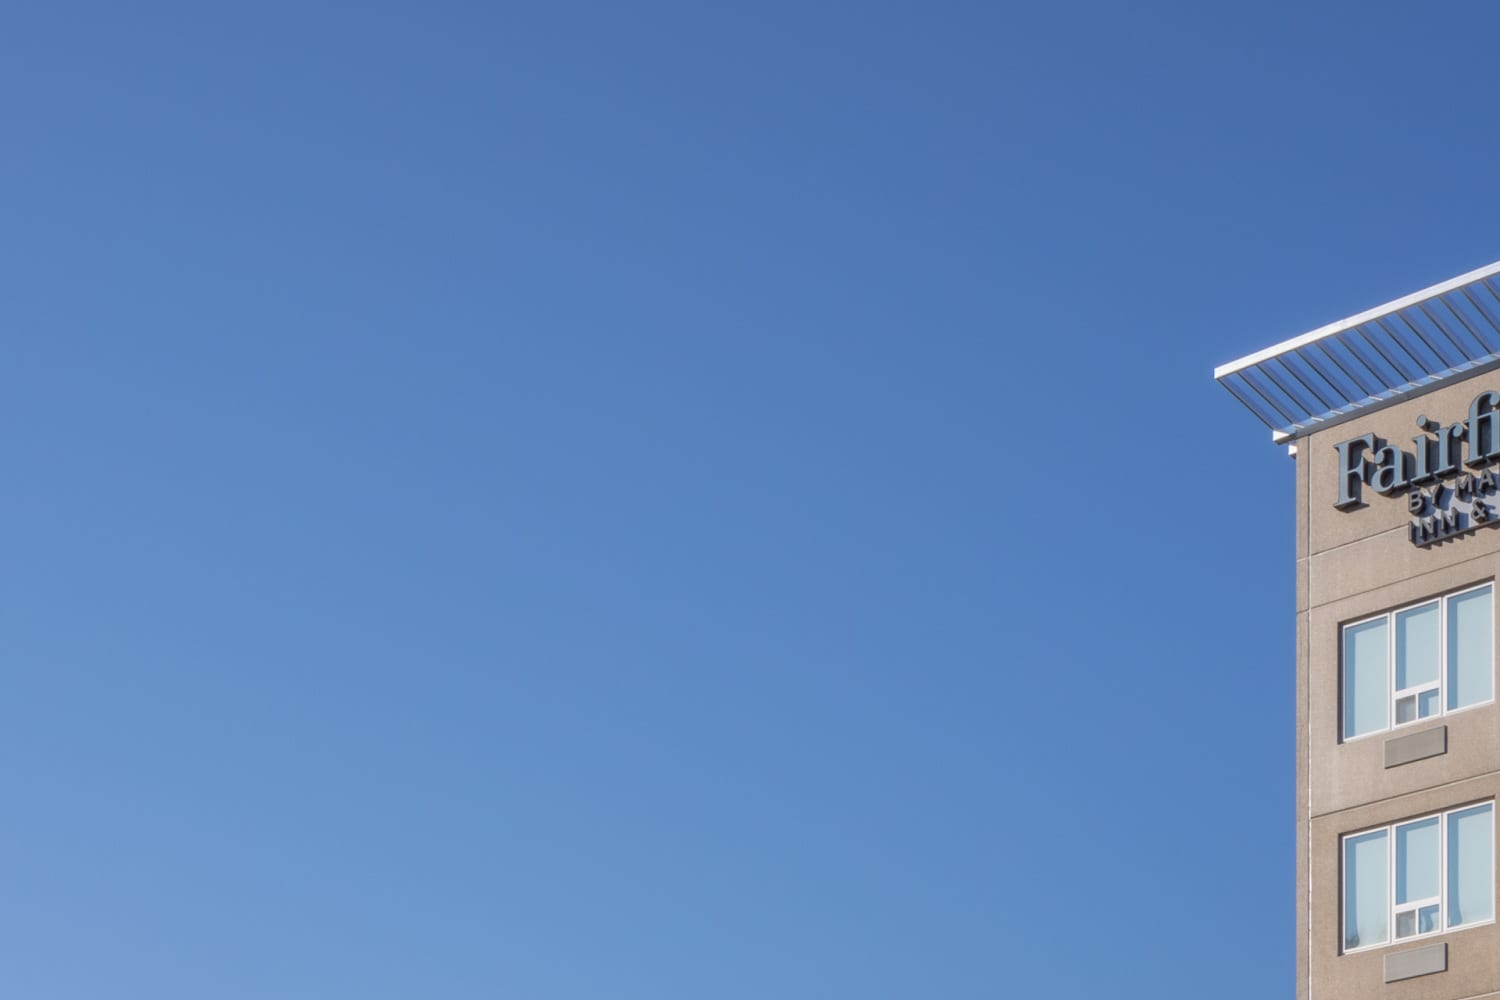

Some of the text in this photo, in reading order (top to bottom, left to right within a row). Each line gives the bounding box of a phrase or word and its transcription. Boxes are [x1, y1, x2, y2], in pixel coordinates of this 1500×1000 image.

[1408, 482, 1444, 513] BY
[1408, 506, 1458, 542] INN
[1471, 498, 1488, 523] &
